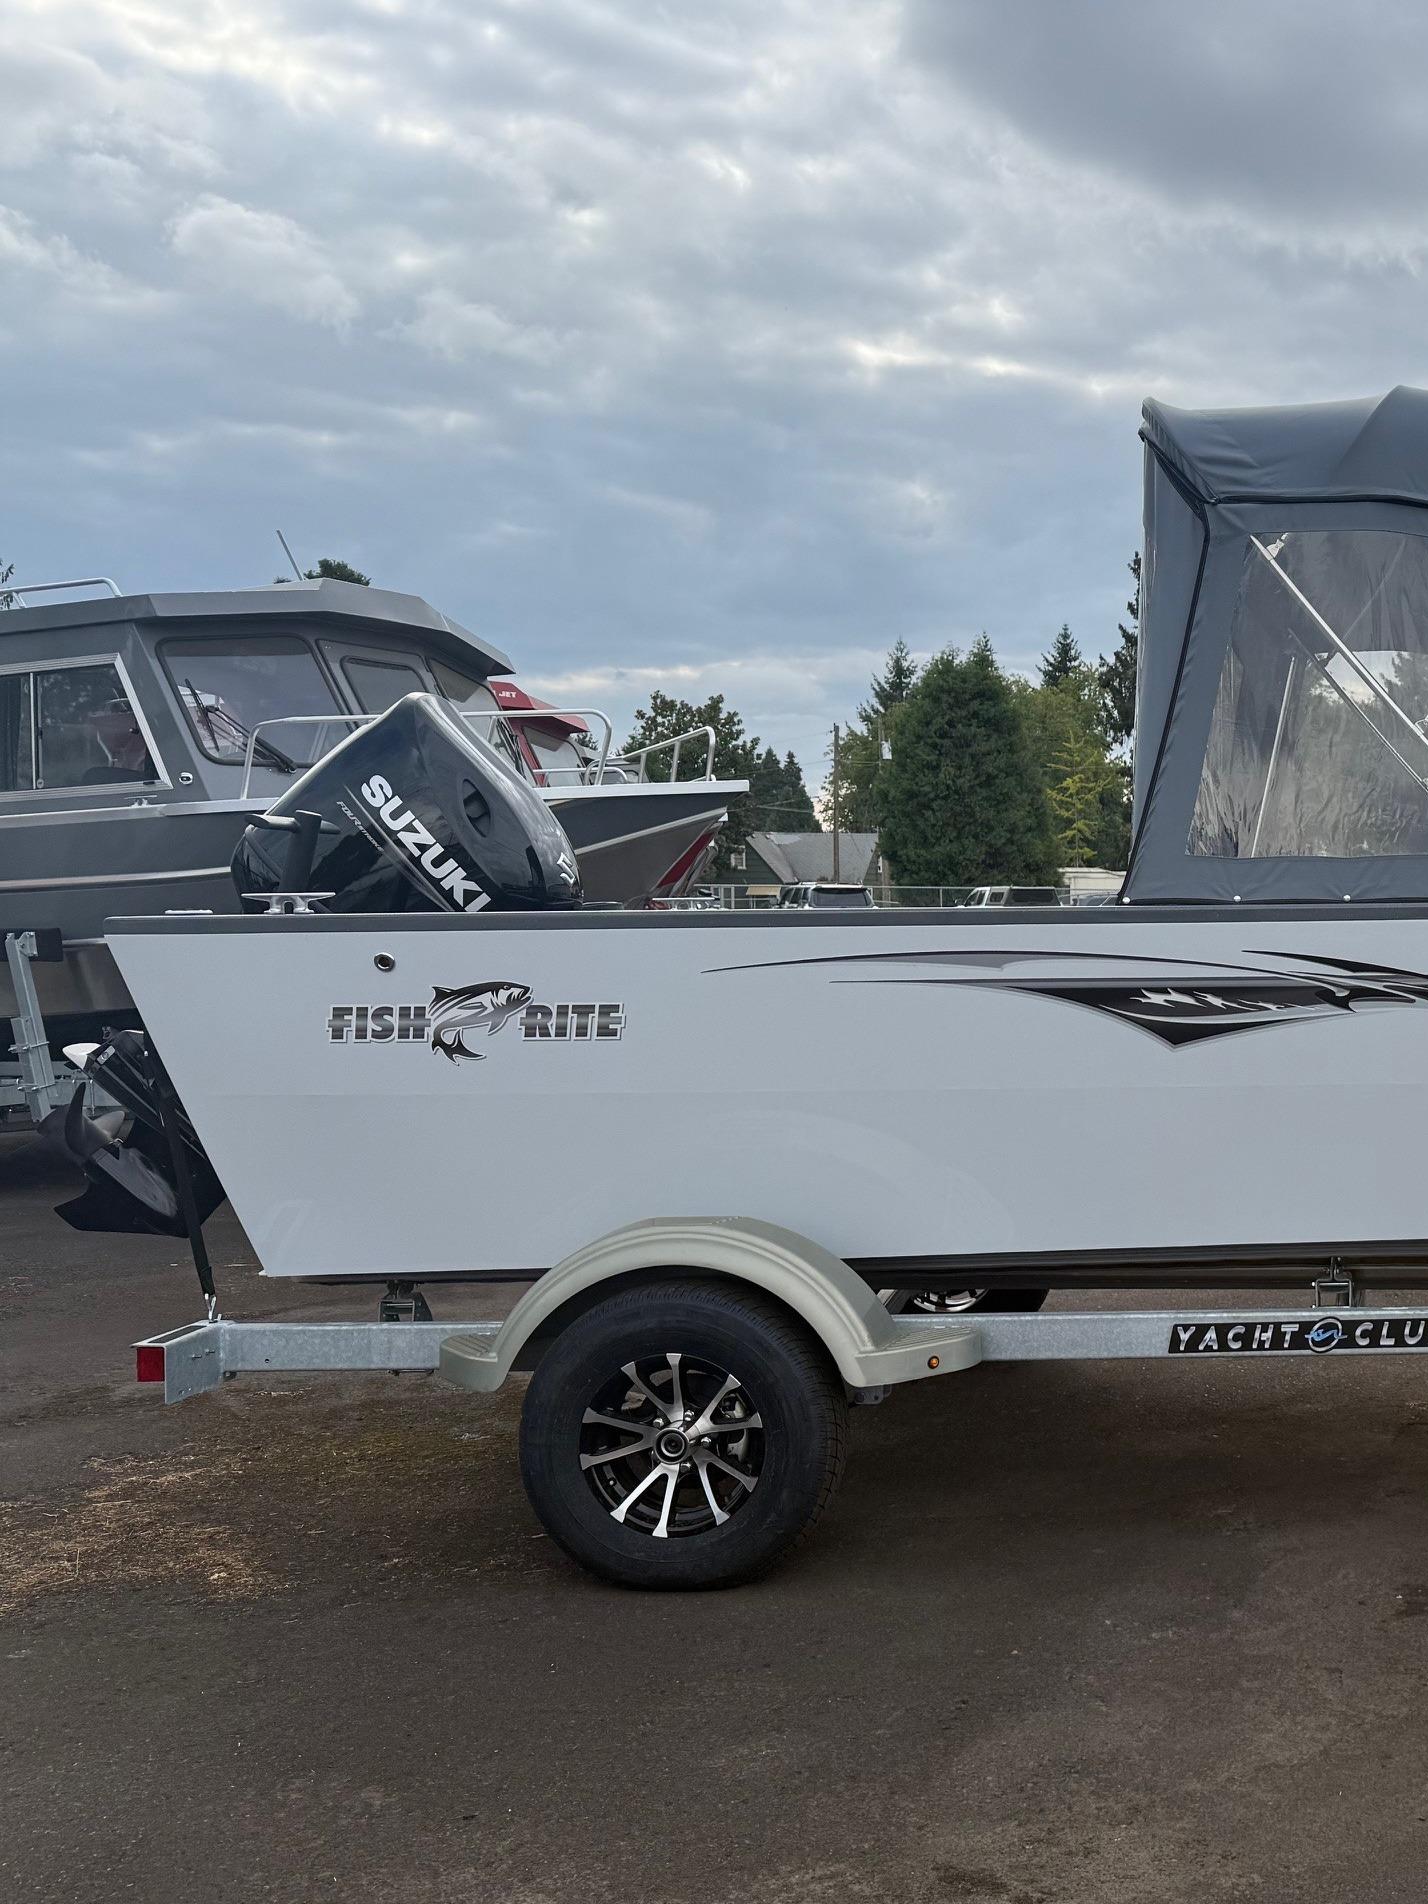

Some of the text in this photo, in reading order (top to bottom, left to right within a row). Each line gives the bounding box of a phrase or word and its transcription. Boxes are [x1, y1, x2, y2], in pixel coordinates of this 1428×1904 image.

[336, 801, 361, 826] FOUR
[361, 775, 492, 912] SUZUKI
[328, 1003, 624, 1041] FISH RITE
[1177, 1323, 1299, 1350] YACHT
